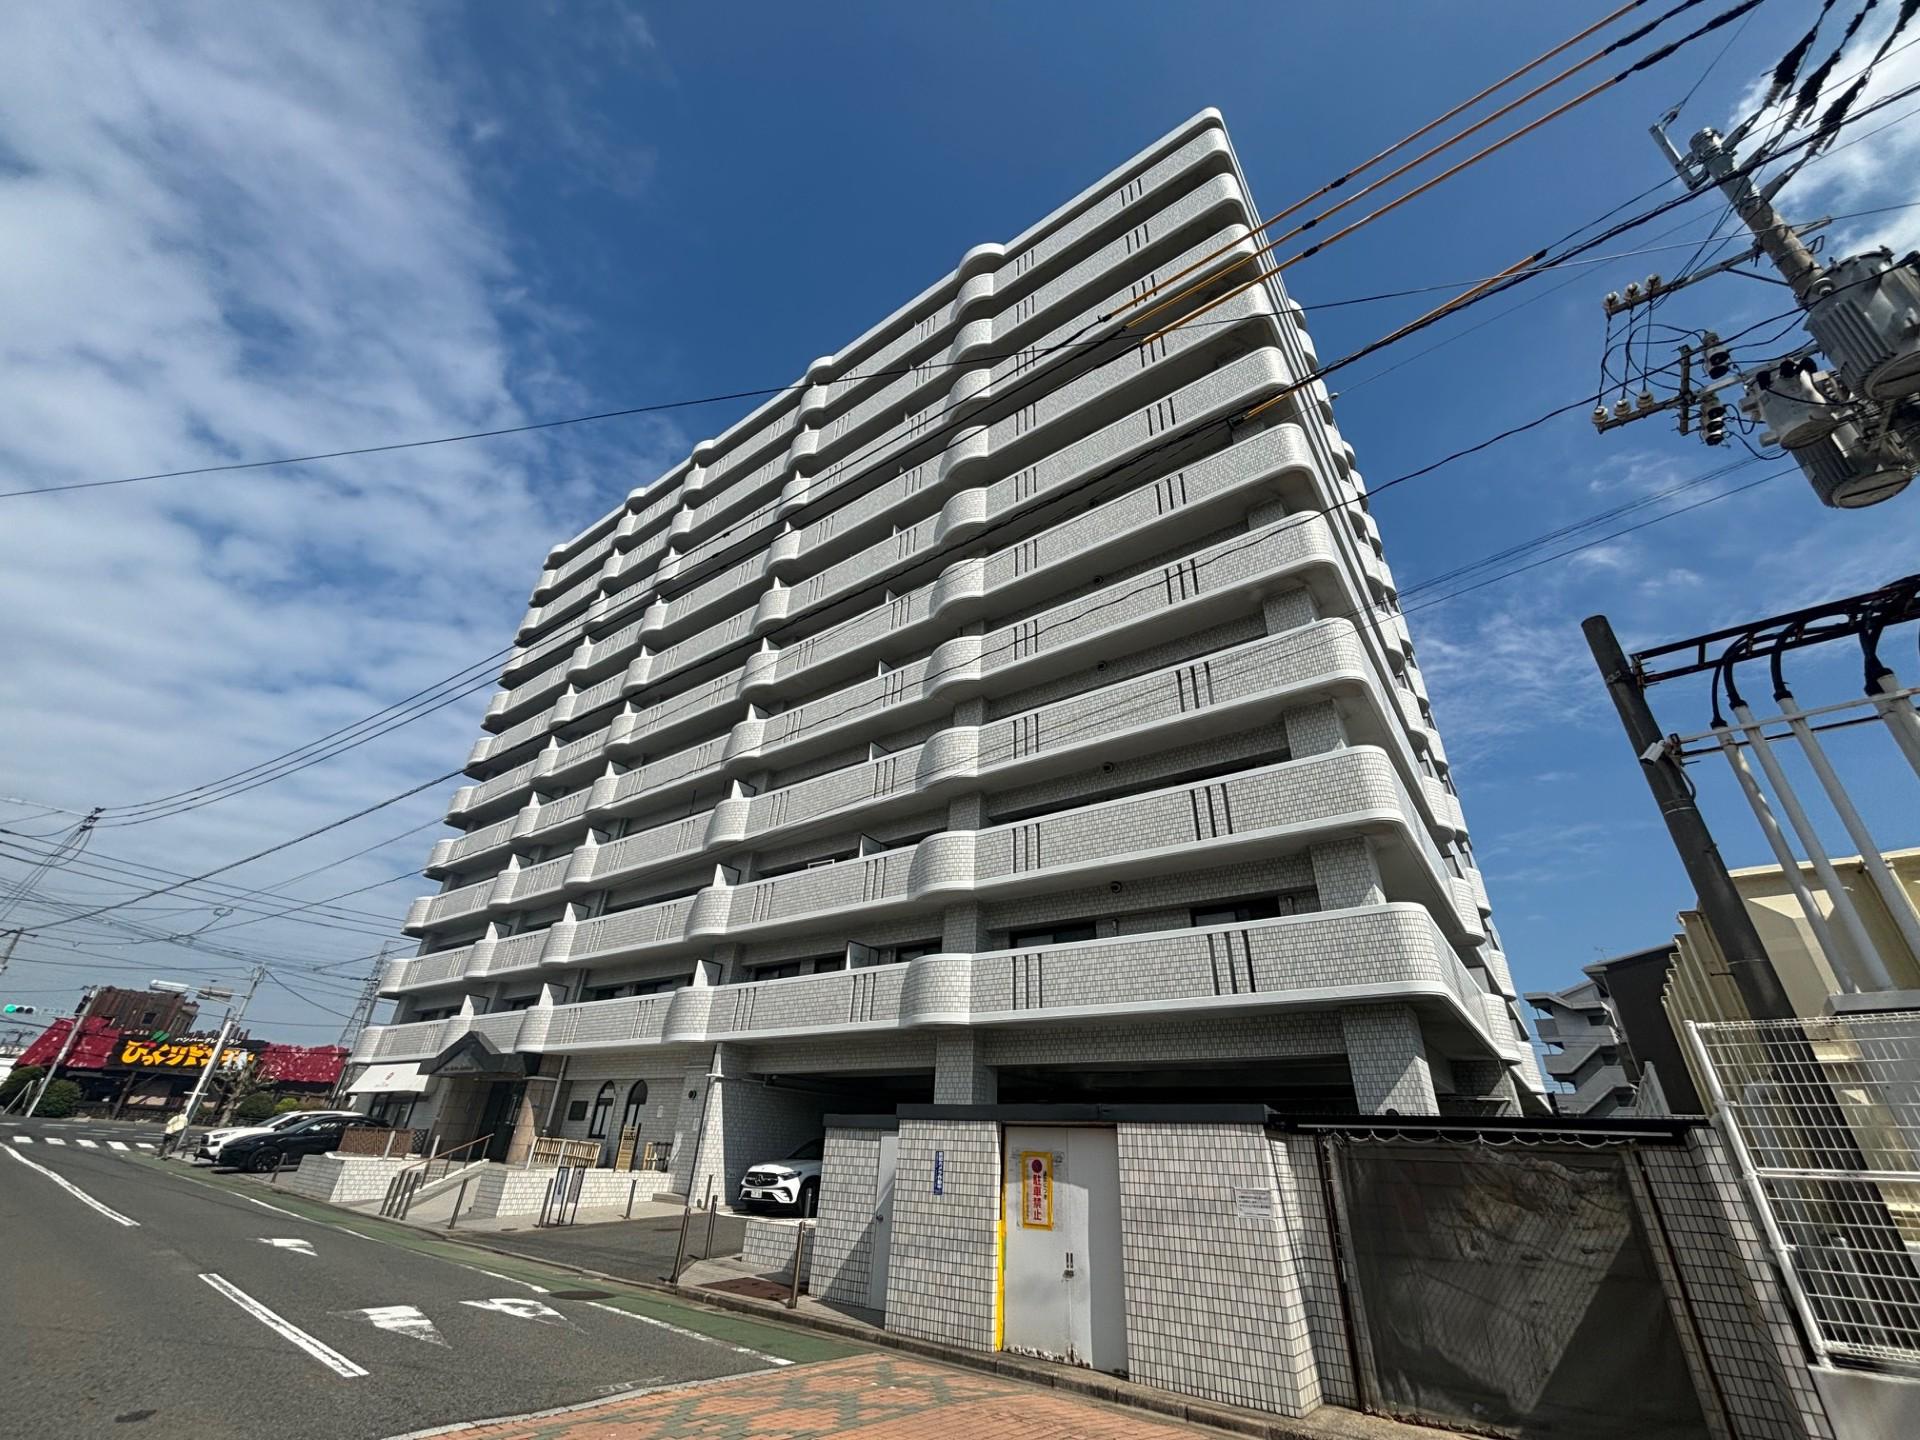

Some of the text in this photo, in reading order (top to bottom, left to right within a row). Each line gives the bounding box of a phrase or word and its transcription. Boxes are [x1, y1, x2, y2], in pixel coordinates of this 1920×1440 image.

[175, 1037, 243, 1045] ハンバーグレラン
[1032, 1174, 1042, 1220] 駐車禁止
